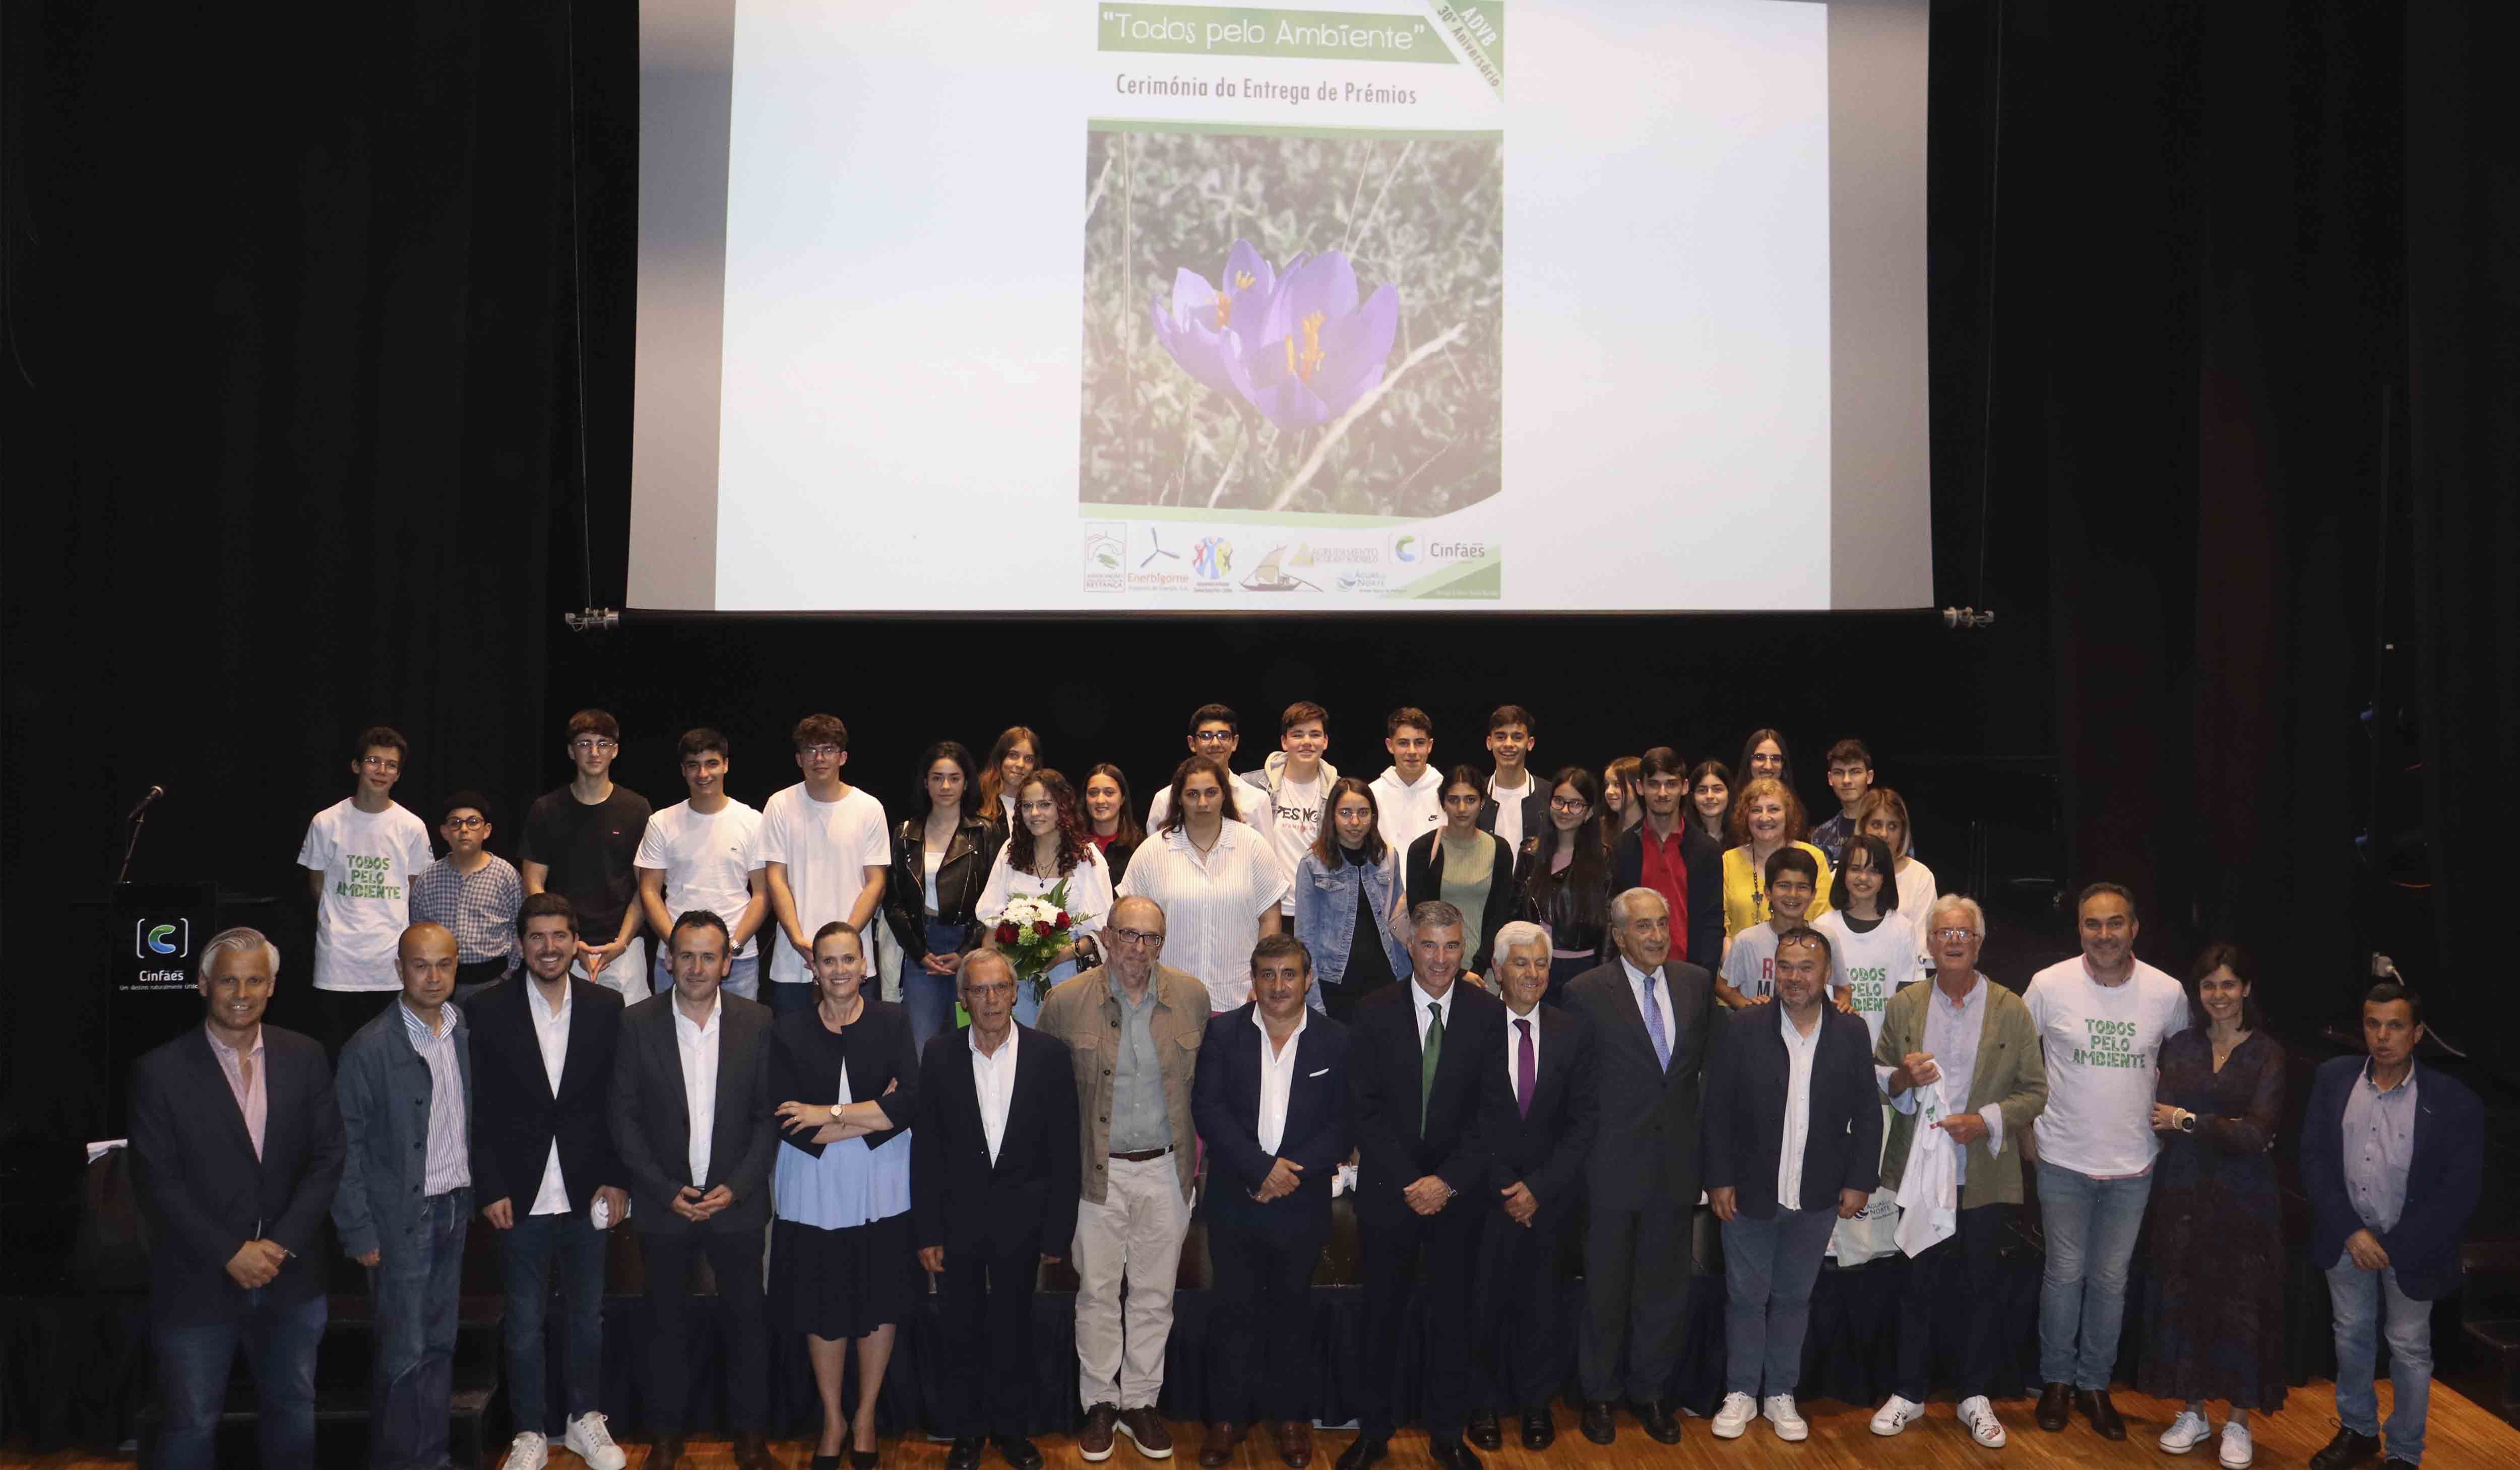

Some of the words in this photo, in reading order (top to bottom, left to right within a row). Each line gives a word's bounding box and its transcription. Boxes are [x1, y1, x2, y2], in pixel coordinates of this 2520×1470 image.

[1207, 19, 1266, 50] pelo
[1460, 7, 1496, 46] ADVB
[1452, 26, 1500, 86] Aniversário
[1116, 74, 1208, 96] Cerimónia
[1216, 77, 1236, 97] da
[1243, 78, 1310, 105] Entrega
[1317, 81, 1338, 101] de
[1345, 82, 1417, 104] Prémios
[346, 854, 392, 871] TODOS
[352, 869, 385, 884] PELO
[335, 881, 401, 900] AMBIENTE
[139, 969, 184, 982] Cinfães
[1847, 967, 1886, 981] ODOS
[1851, 983, 1882, 996] PELO
[2085, 1018, 2136, 1037] TODOS
[2090, 1035, 2130, 1052] PELO
[2071, 1048, 2146, 1069] AMBIENTE
